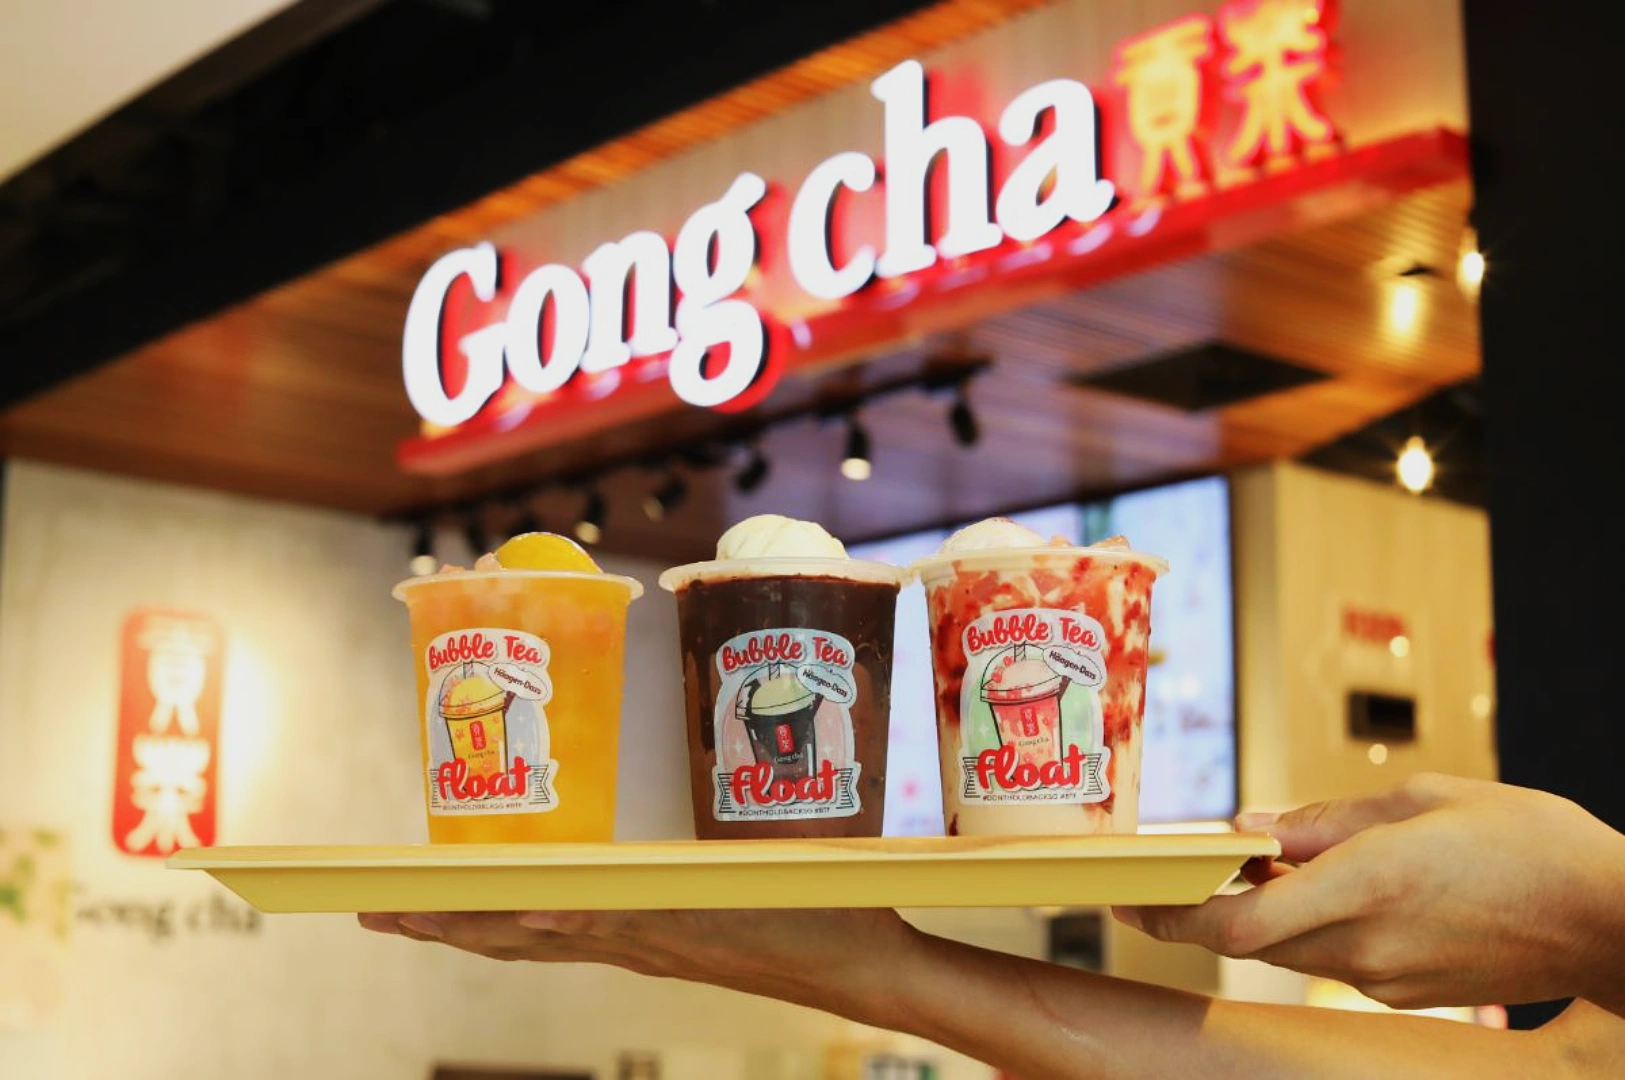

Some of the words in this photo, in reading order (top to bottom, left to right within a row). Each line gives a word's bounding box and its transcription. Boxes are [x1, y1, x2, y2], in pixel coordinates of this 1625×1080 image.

[402, 173, 767, 425] Gong
[789, 60, 1115, 299] cha
[428, 633, 495, 670] Bubble
[504, 635, 543, 664] Tea
[722, 633, 803, 671] Bubble
[813, 637, 848, 665] Tea
[967, 614, 1049, 651] Bubble
[1060, 617, 1097, 647] Tea
[436, 756, 532, 800] Float
[731, 759, 840, 804] Float
[975, 744, 1087, 789] Float
